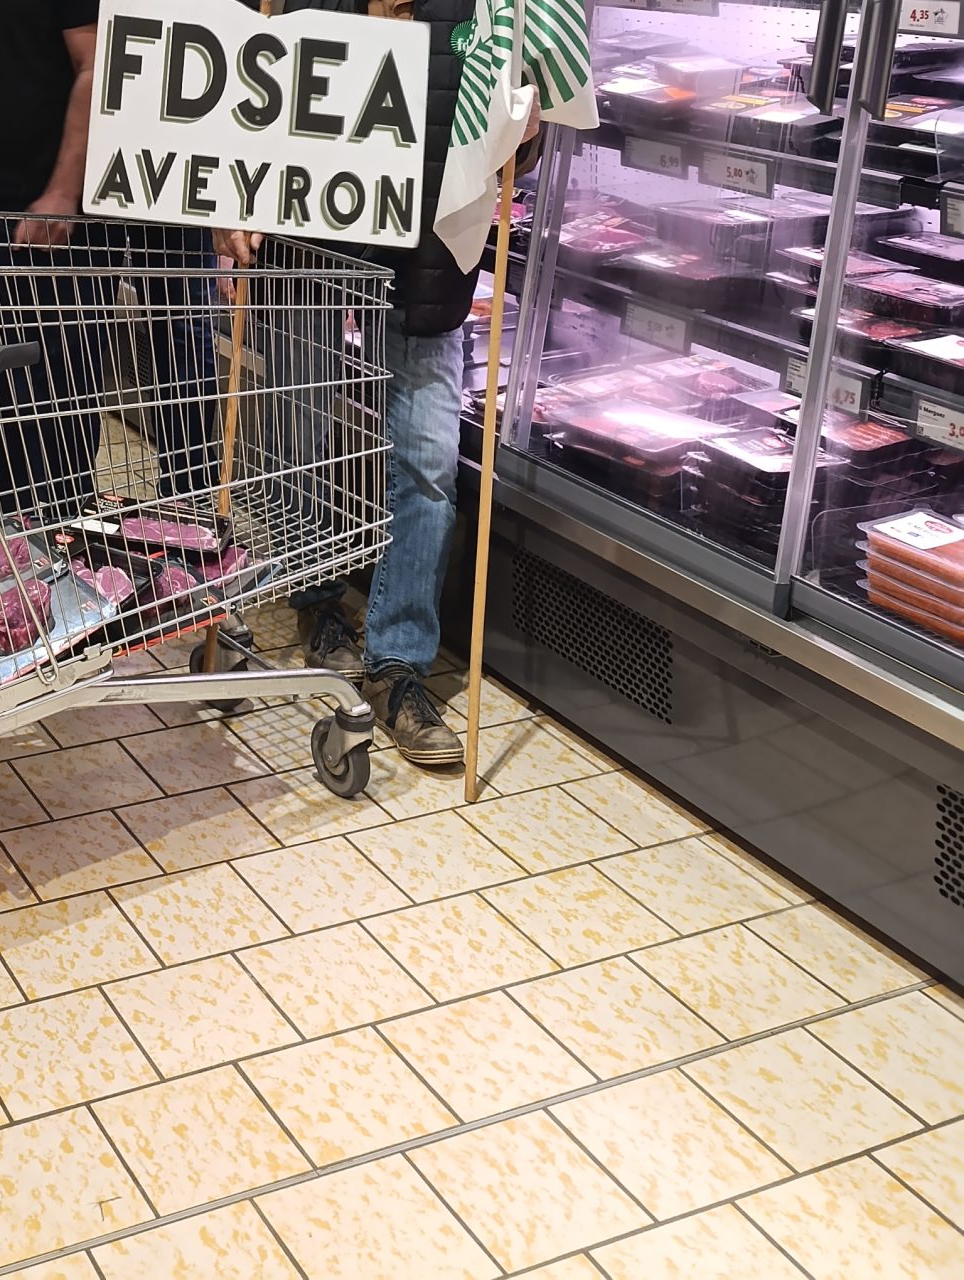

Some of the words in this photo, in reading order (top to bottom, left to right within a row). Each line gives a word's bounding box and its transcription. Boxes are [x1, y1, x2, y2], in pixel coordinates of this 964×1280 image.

[909, 9, 930, 23] 4.35
[100, 14, 418, 149] FDSEA
[90, 146, 415, 238] AVEYRON
